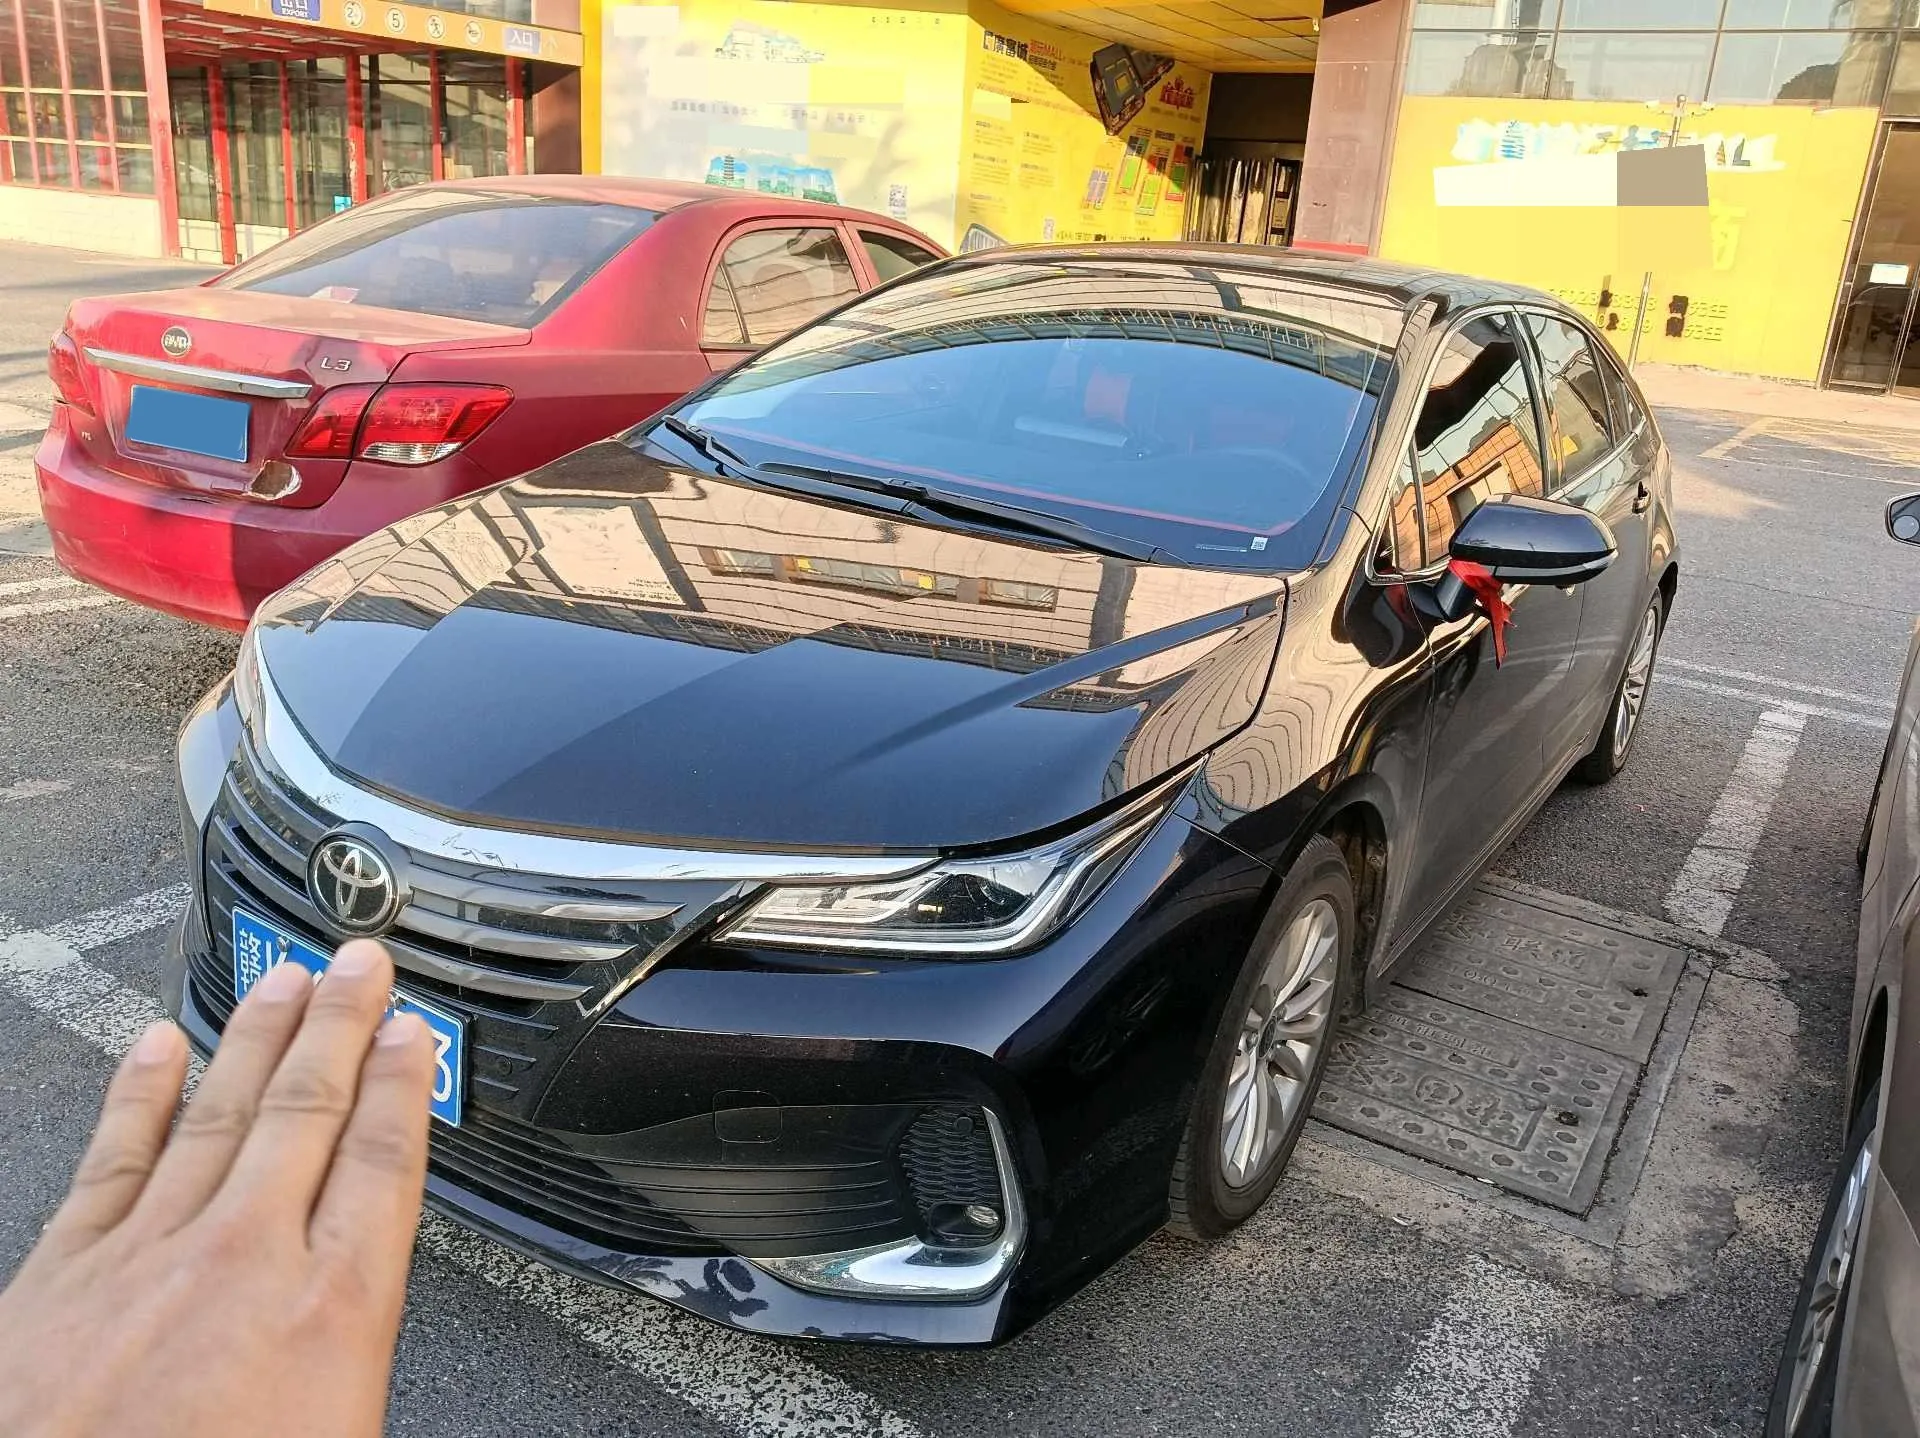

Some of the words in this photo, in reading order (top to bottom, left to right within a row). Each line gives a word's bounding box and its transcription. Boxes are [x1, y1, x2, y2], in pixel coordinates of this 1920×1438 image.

[391, 12, 401, 28] 5
[509, 29, 533, 47] 入口
[319, 355, 353, 372] L3
